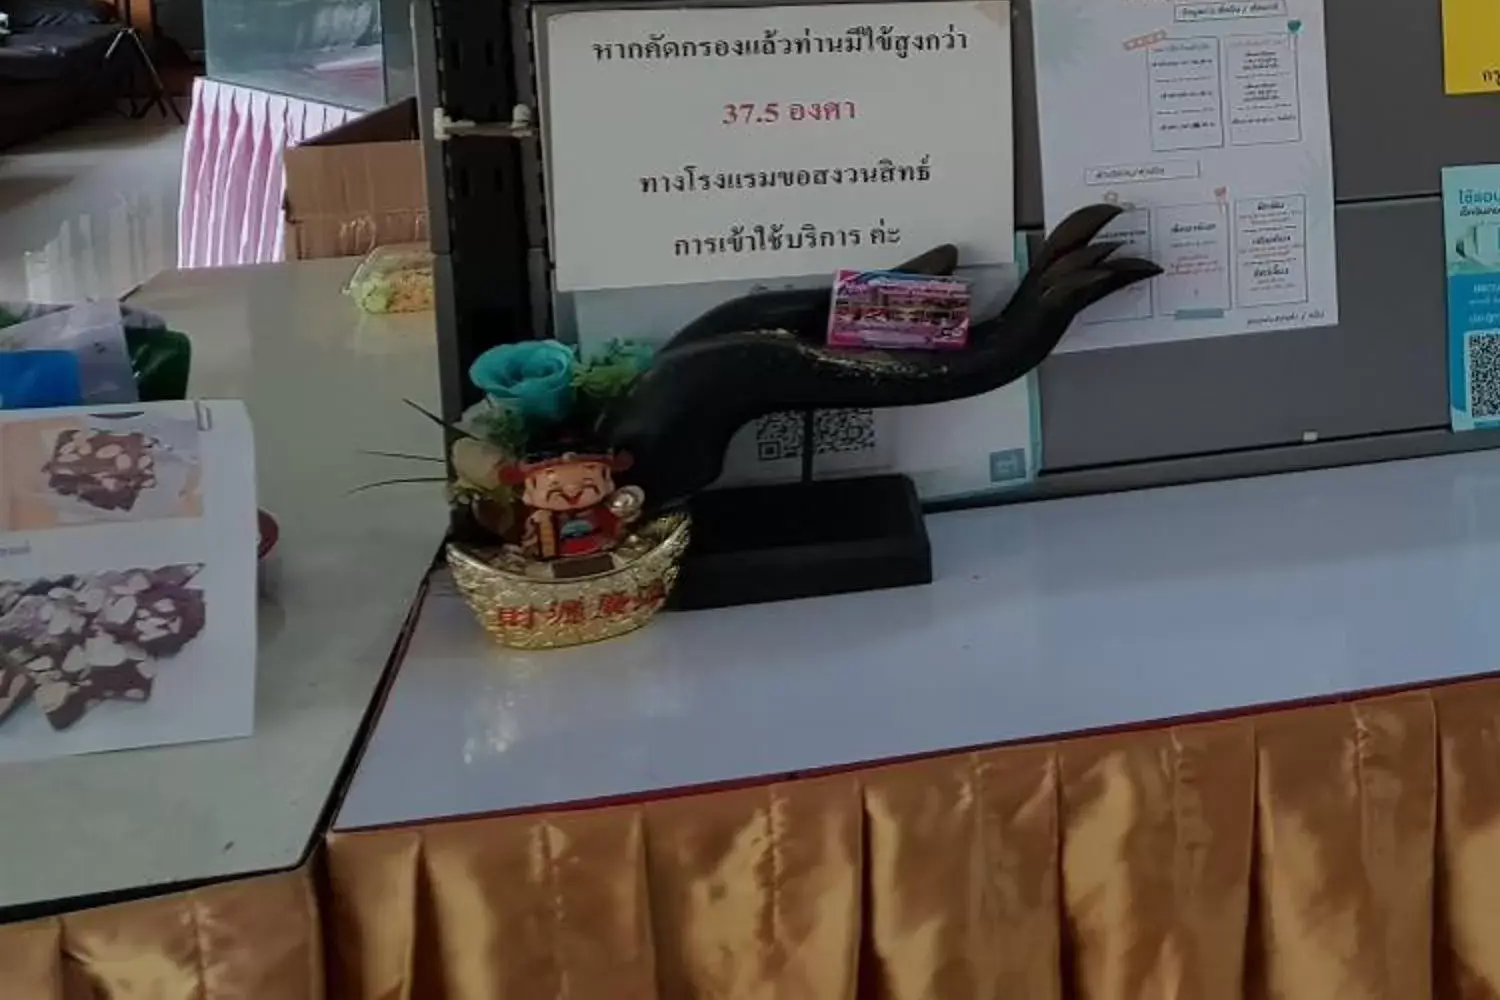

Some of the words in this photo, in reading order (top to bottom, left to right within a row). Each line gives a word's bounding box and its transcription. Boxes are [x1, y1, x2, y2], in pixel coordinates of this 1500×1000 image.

[722, 102, 780, 125] 37.5
[789, 101, 857, 122] องศา
[674, 222, 862, 258] การเข้าใช้บริการ
[869, 217, 902, 246] ค่ะ
